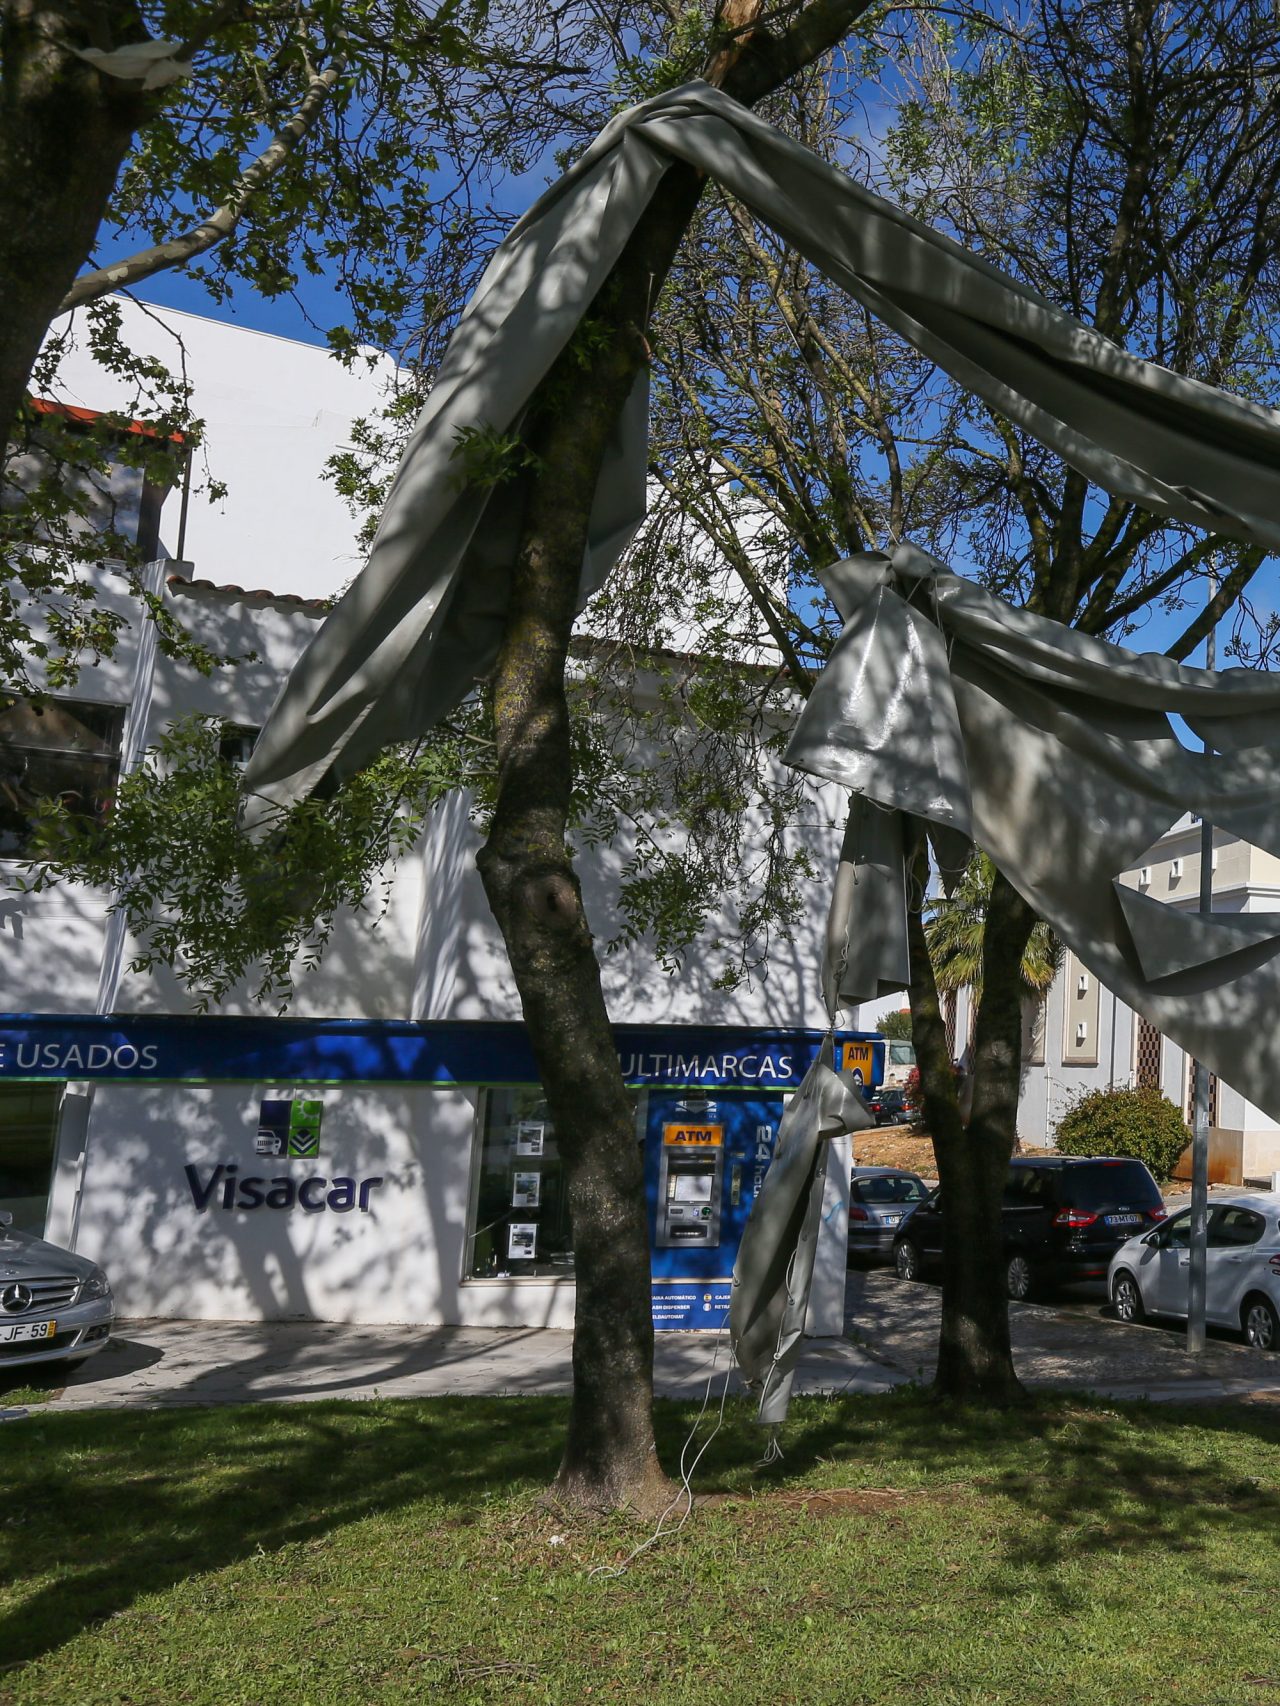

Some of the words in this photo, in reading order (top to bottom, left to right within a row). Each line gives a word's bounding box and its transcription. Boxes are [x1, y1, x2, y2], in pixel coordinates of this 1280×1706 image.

[16, 1044, 158, 1069] USADOS
[848, 1046, 869, 1061] ATM
[617, 1054, 793, 1079] ULTIMARCAS
[675, 1130, 712, 1142] ATM
[755, 1125, 772, 1162] 24
[184, 1164, 383, 1214] Visacar
[753, 1165, 766, 1198] hou
